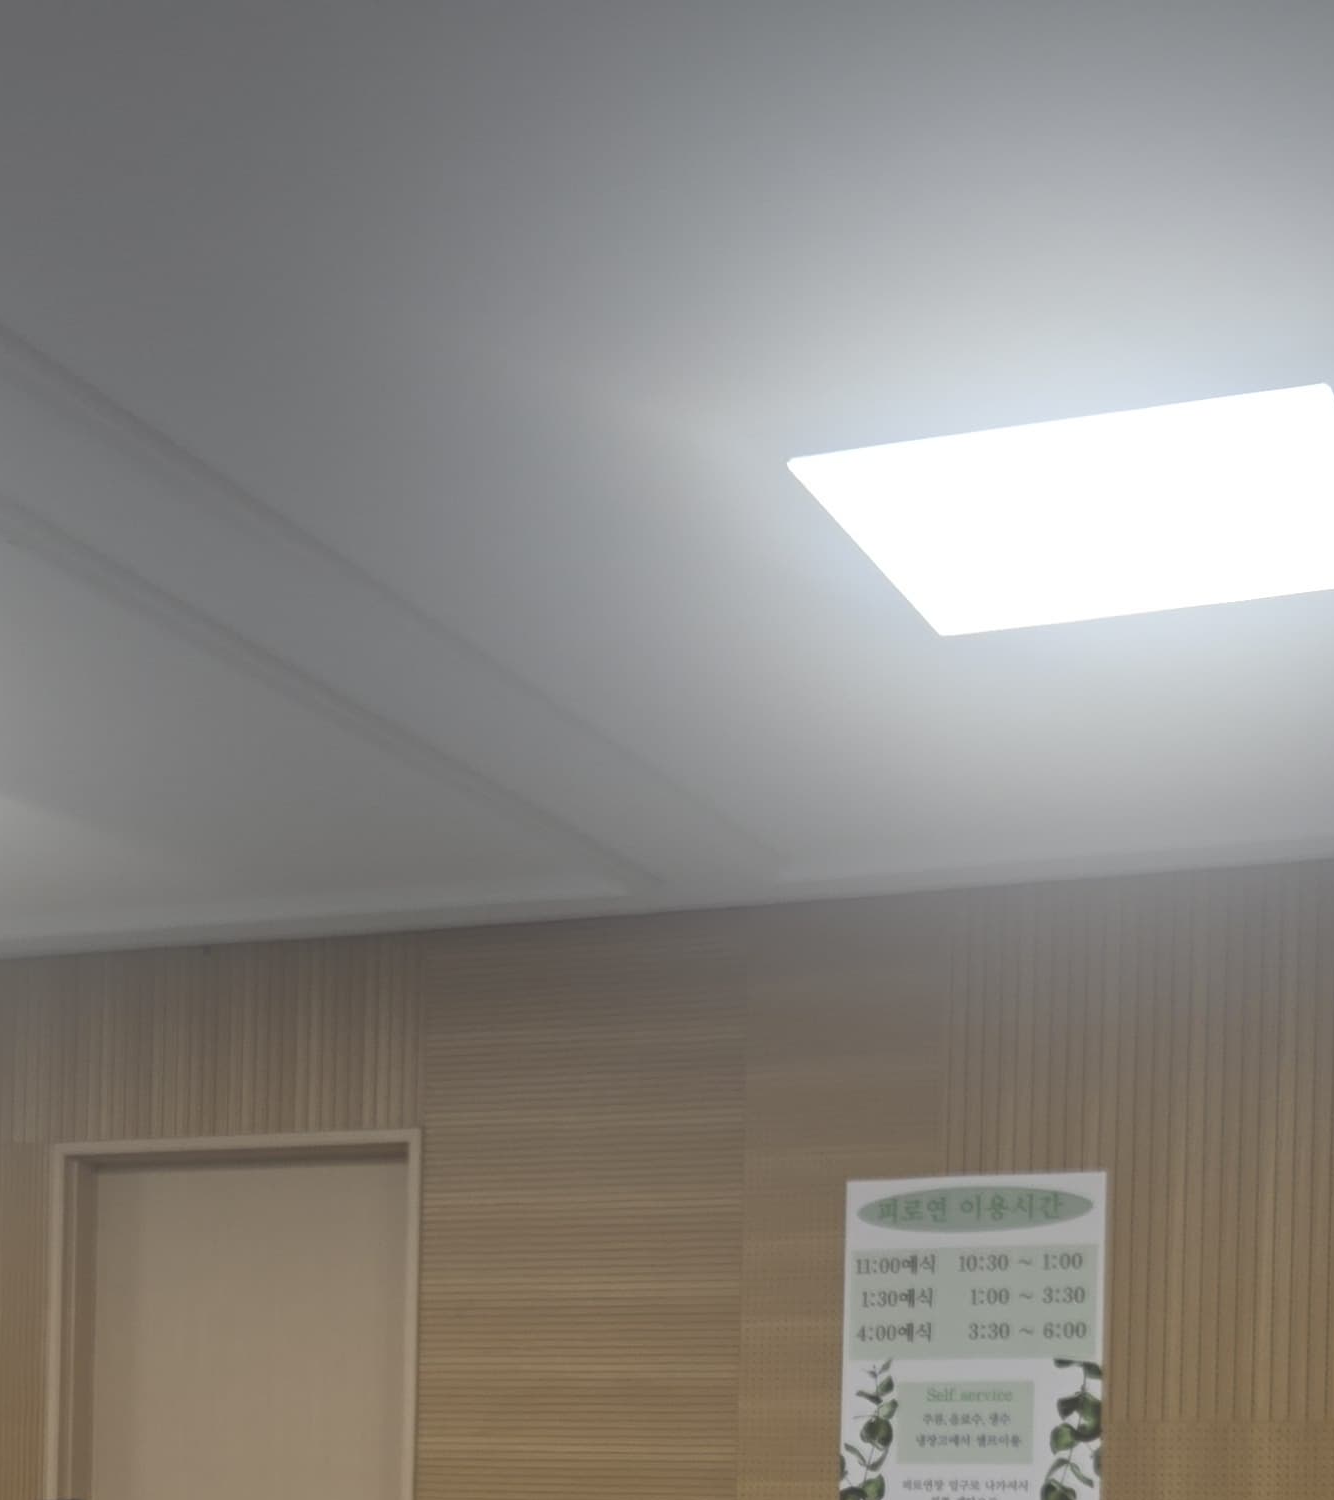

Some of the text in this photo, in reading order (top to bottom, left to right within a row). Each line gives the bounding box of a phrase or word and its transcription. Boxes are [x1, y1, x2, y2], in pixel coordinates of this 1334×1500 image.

[878, 1191, 1065, 1225] 피로연 이용시간
[958, 1254, 1009, 1272] 10:30
[1042, 1252, 1084, 1270] 1:00
[969, 1288, 1010, 1306] 1:00
[1042, 1286, 1086, 1304] 3:30
[968, 1322, 1011, 1340] 3:30
[1042, 1321, 1087, 1340] 6:00
